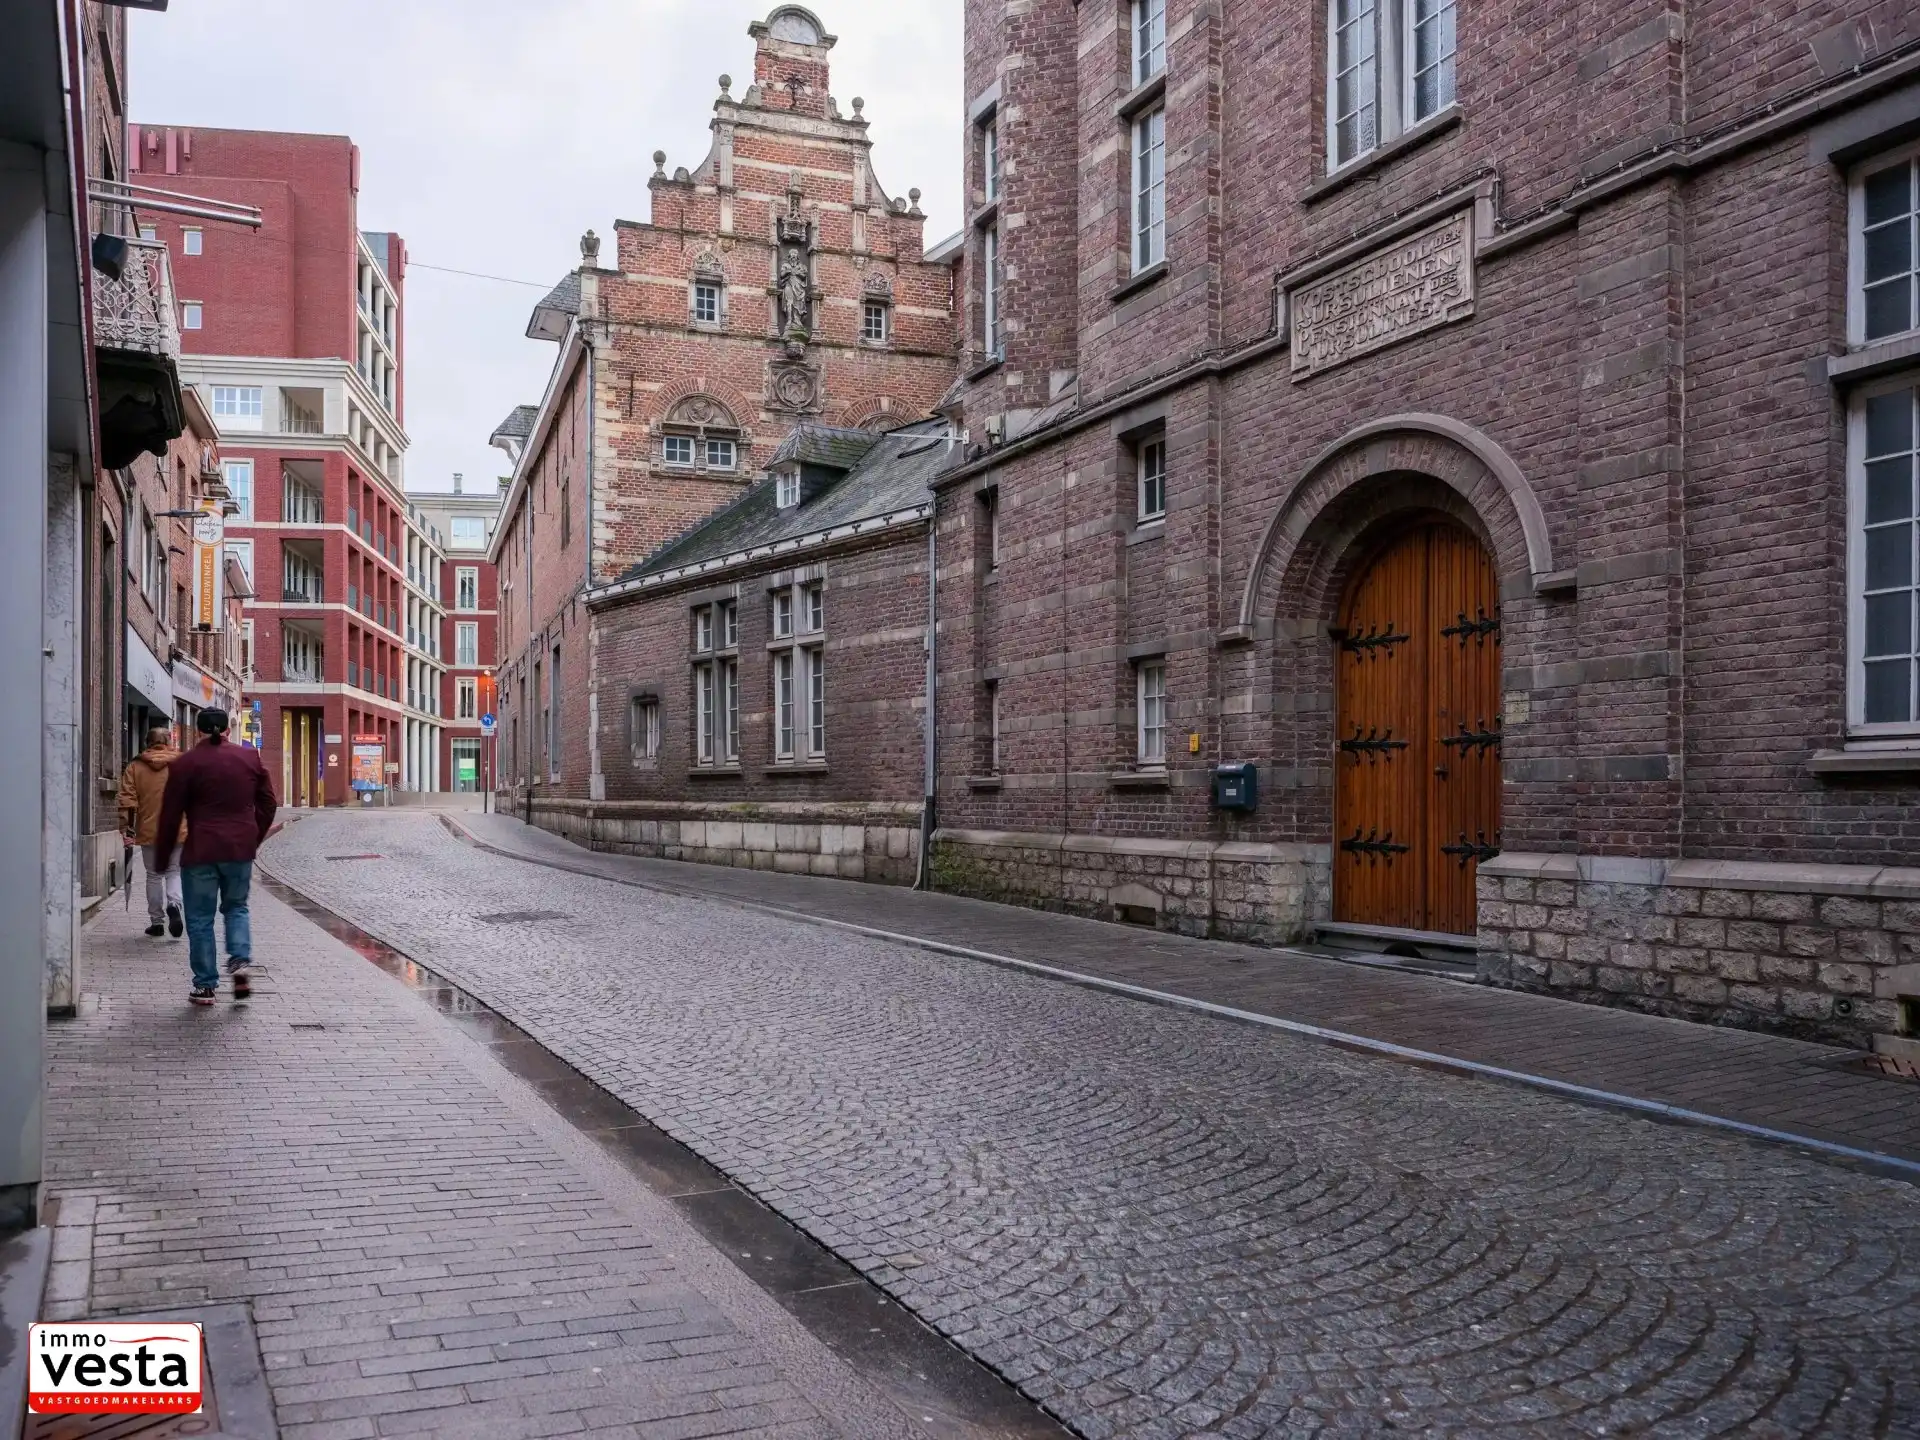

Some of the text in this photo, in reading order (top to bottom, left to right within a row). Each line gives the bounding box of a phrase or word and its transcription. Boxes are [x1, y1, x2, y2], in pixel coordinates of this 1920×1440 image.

[1434, 228, 1463, 249] DER
[1429, 272, 1458, 292] DES
[203, 553, 213, 623] NATUURWINKEL
